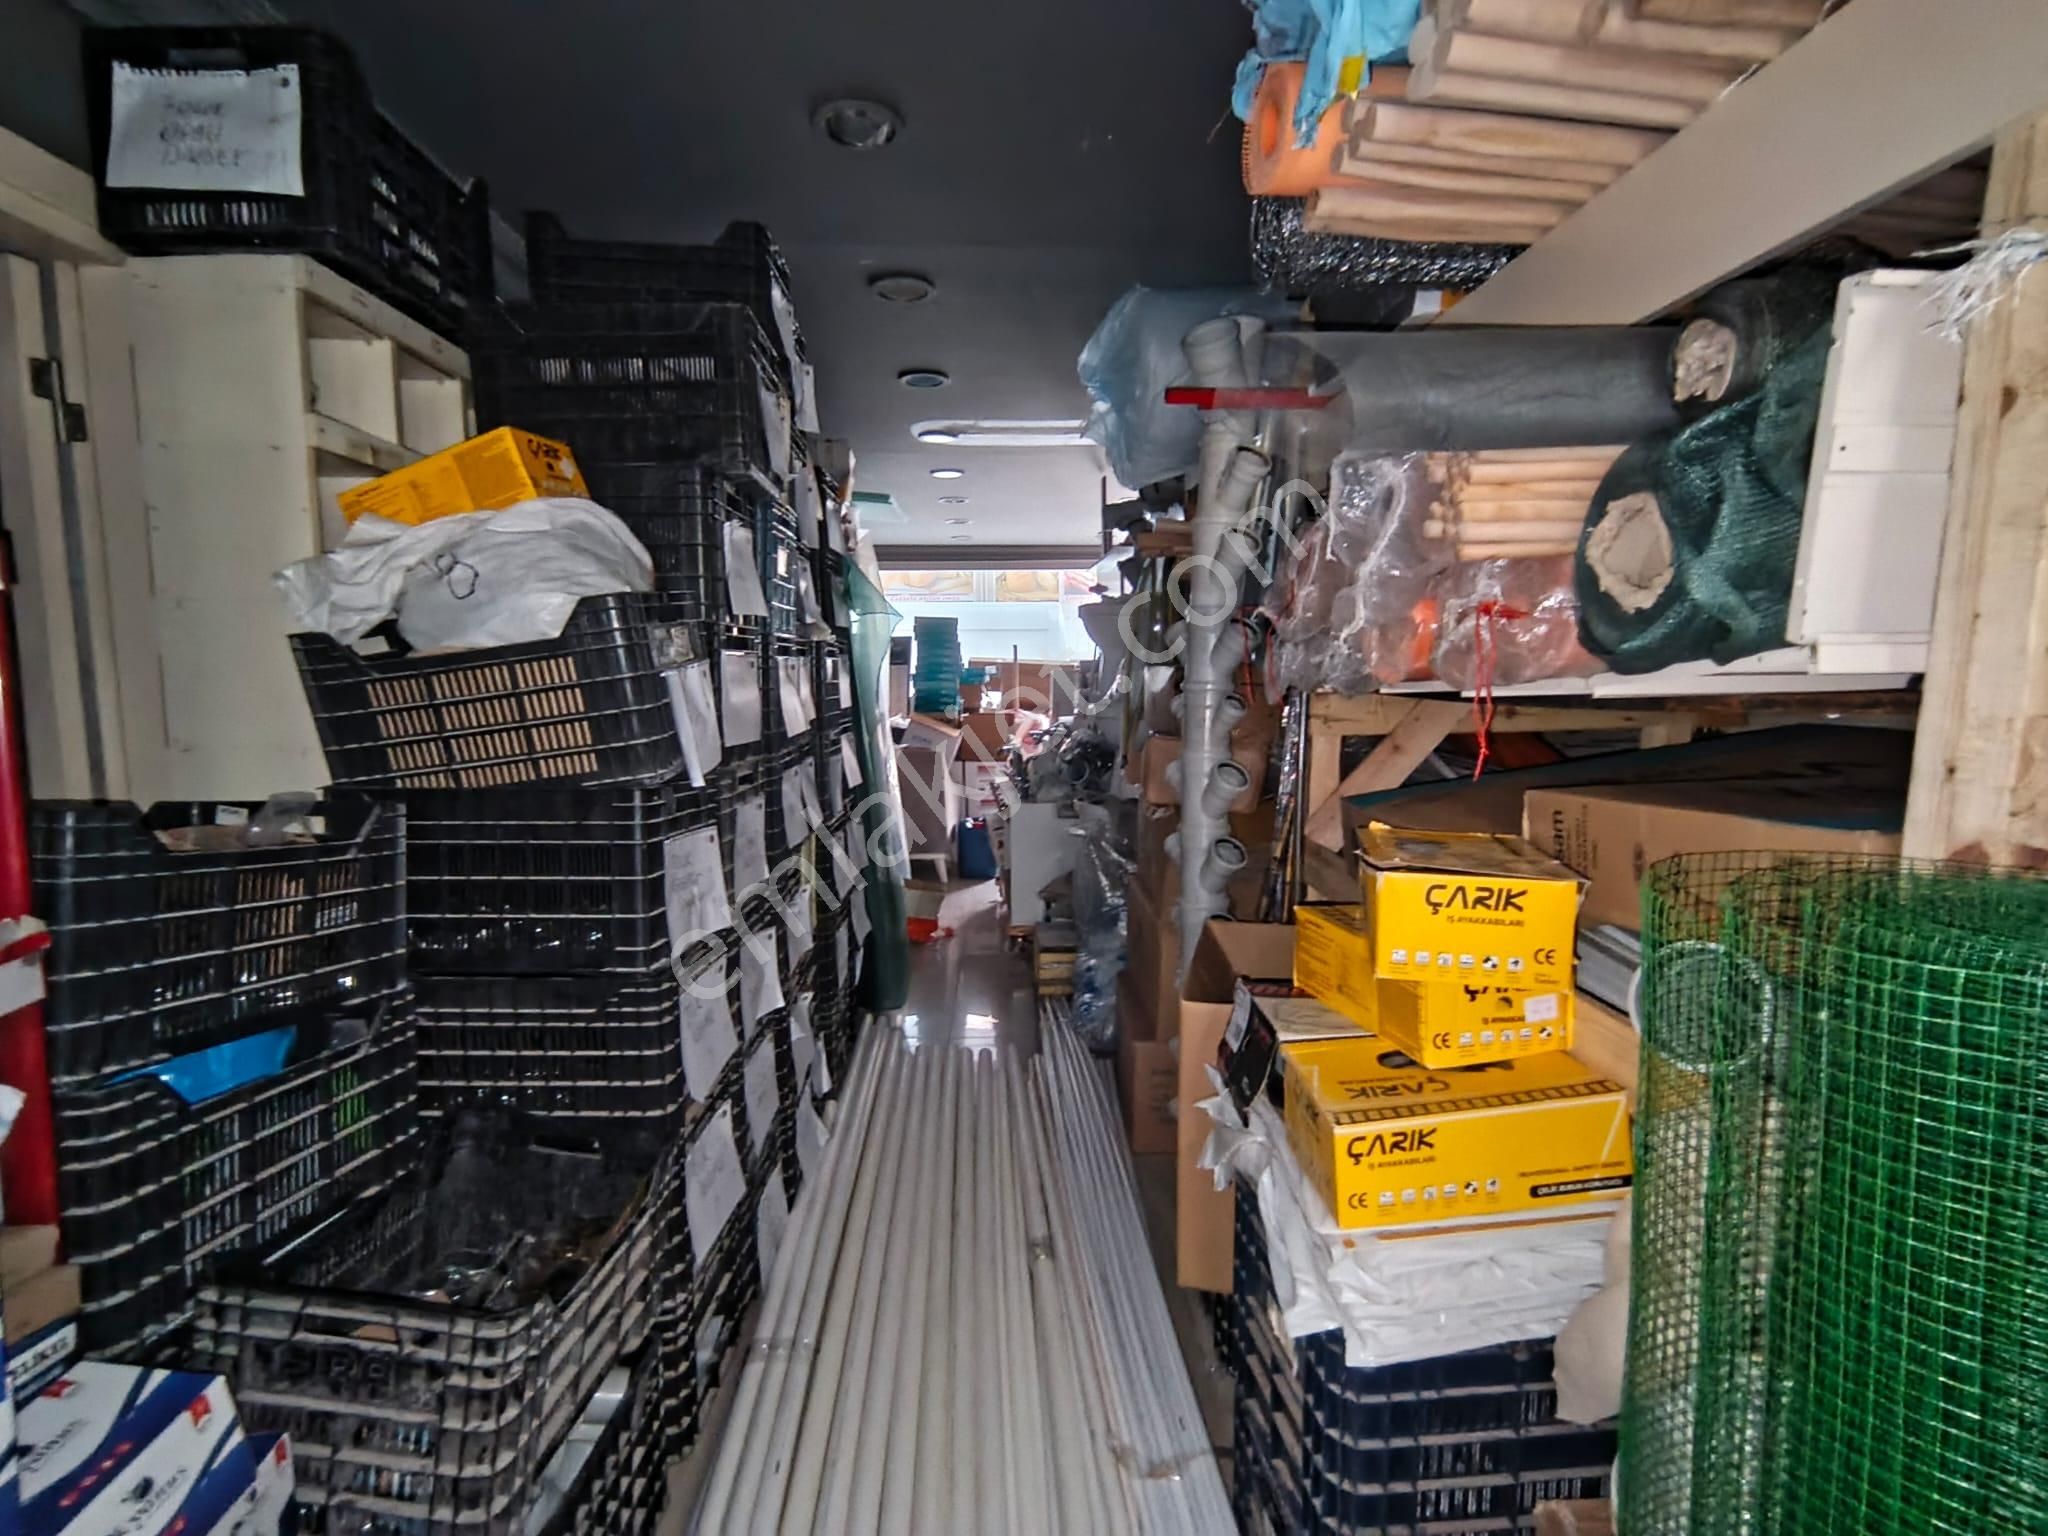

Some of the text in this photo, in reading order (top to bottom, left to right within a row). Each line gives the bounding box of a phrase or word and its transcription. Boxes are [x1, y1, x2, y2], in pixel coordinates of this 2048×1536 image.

[1425, 884, 1528, 915] ÇARIK
[1534, 948, 1557, 966] CE
[1432, 1032, 1451, 1050] CE
[1343, 1076, 1451, 1099] ÇARIK
[1347, 1127, 1438, 1165] ÇARIK
[1348, 1192, 1369, 1210] CE
